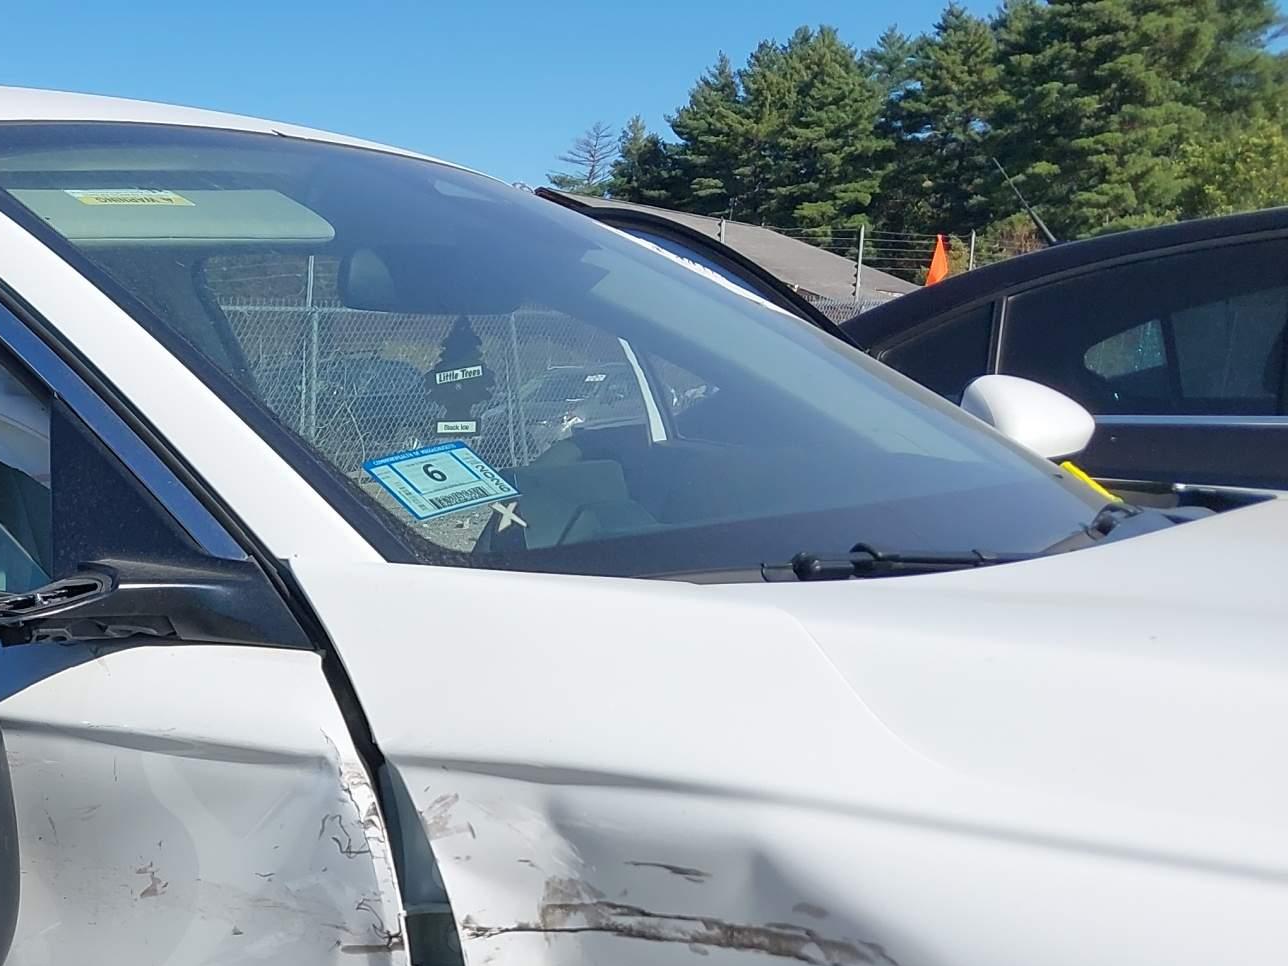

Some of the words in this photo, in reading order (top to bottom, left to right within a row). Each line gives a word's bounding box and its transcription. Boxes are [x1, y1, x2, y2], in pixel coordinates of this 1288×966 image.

[439, 371, 459, 383] Little
[460, 369, 480, 378] Trees
[422, 463, 447, 482] 6
[475, 464, 511, 492] 2026
